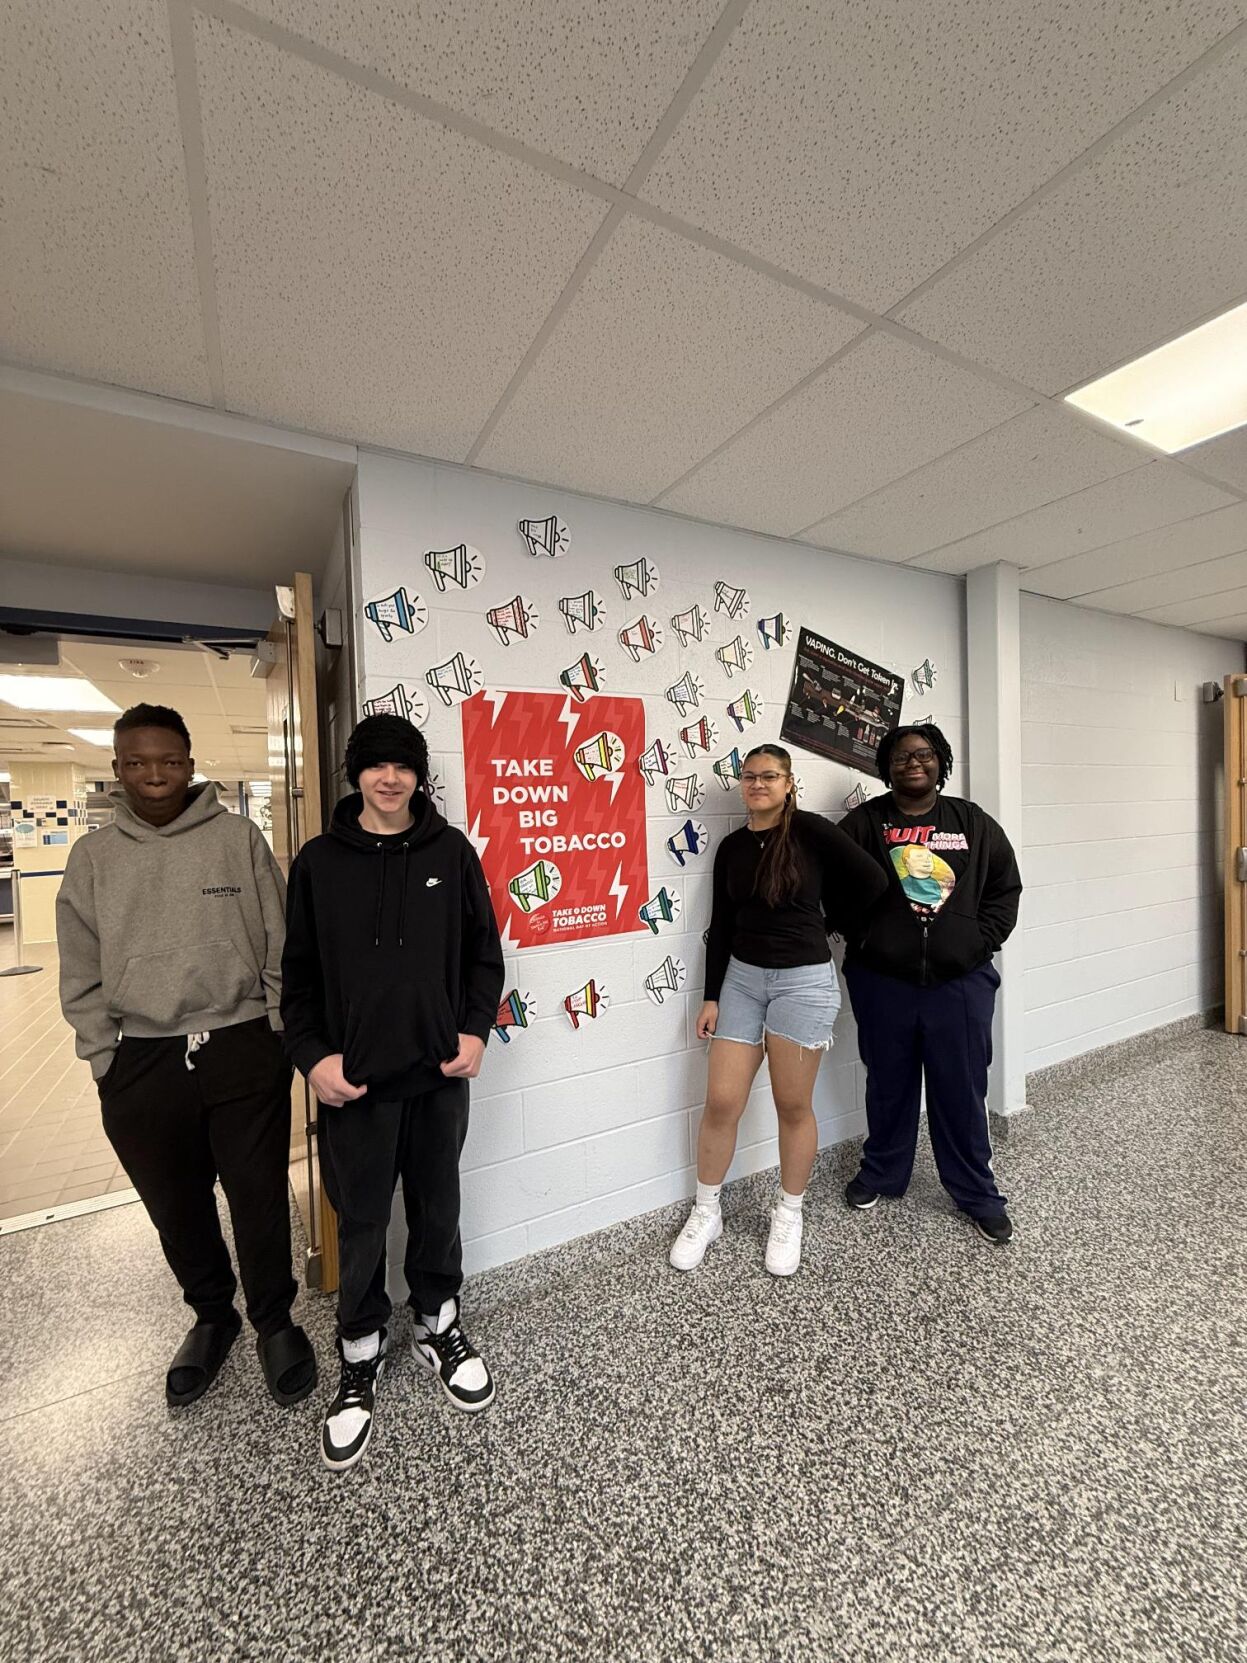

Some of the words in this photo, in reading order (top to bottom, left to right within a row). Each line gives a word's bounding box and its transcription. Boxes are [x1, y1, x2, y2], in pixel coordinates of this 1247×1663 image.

[805, 635, 836, 659] VAPING.
[837, 652, 857, 668] Don't
[857, 663, 870, 676] Get
[491, 759, 554, 777] TAKE
[492, 785, 568, 805] DOWN
[518, 809, 558, 828] BIG
[520, 832, 626, 855] TOBACCO
[924, 840, 969, 850] THINGS
[552, 908, 573, 917] TAKE
[581, 904, 606, 914] DOWN
[552, 912, 607, 928] TOBACCO
